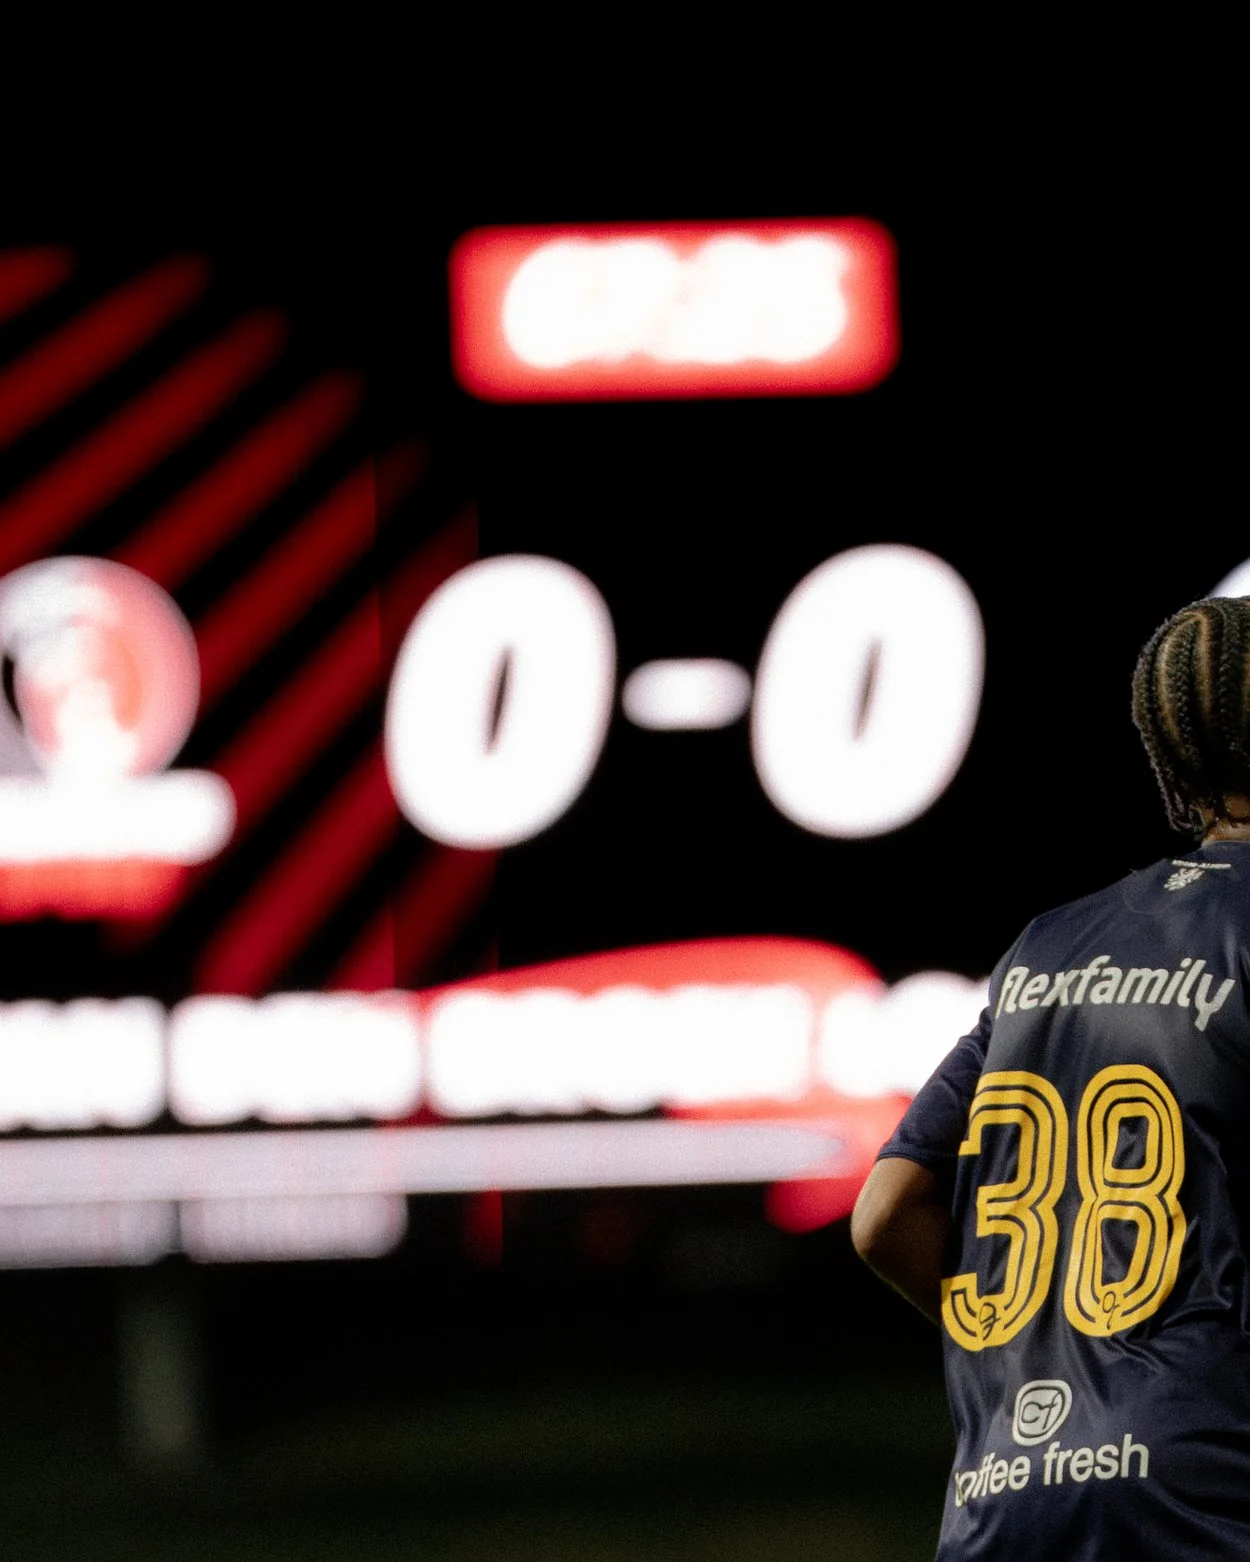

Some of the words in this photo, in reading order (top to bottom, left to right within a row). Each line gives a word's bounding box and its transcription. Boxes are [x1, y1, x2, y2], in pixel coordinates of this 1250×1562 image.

[995, 955, 1236, 1032] flexfamily
[941, 1064, 1187, 1352] 38
[1043, 1433, 1150, 1485] fresh
